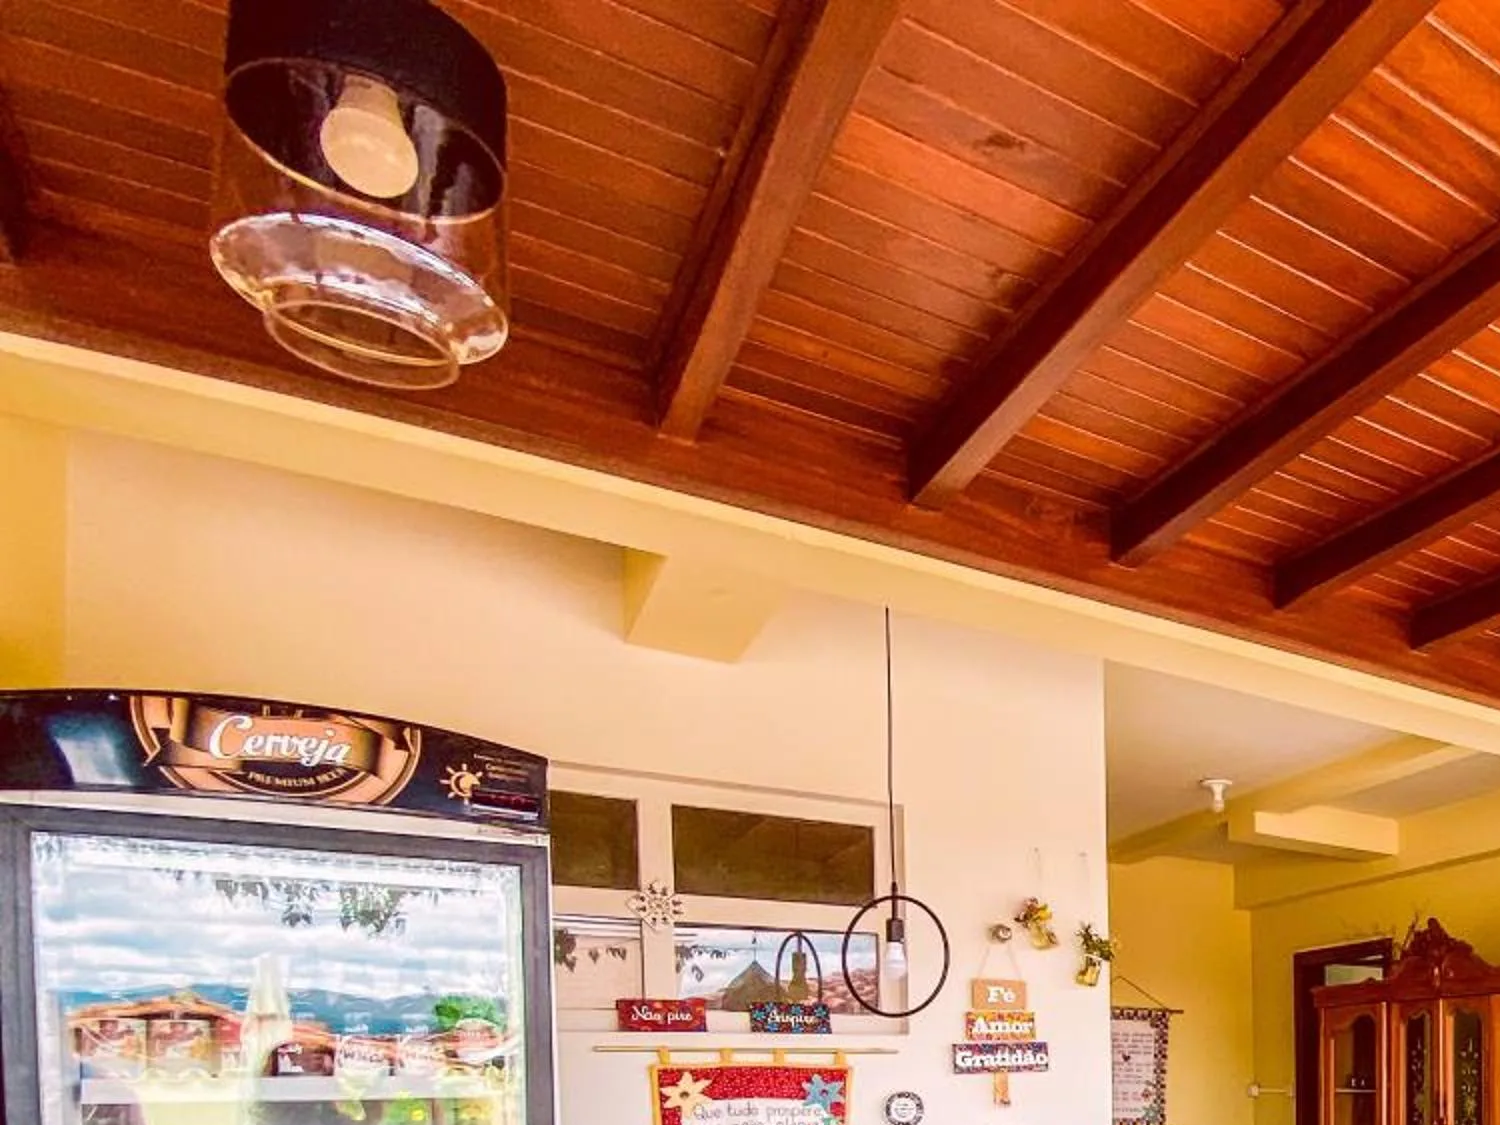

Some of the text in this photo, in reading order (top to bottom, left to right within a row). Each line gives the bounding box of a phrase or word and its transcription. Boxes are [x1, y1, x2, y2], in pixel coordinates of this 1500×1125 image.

[208, 715, 351, 766] Cerveja
[987, 986, 1017, 1003] Fé
[971, 1016, 1034, 1033] Amor
[955, 1048, 1049, 1068] Gratidão
[692, 1103, 722, 1120] Que
[727, 1101, 759, 1117] tudo
